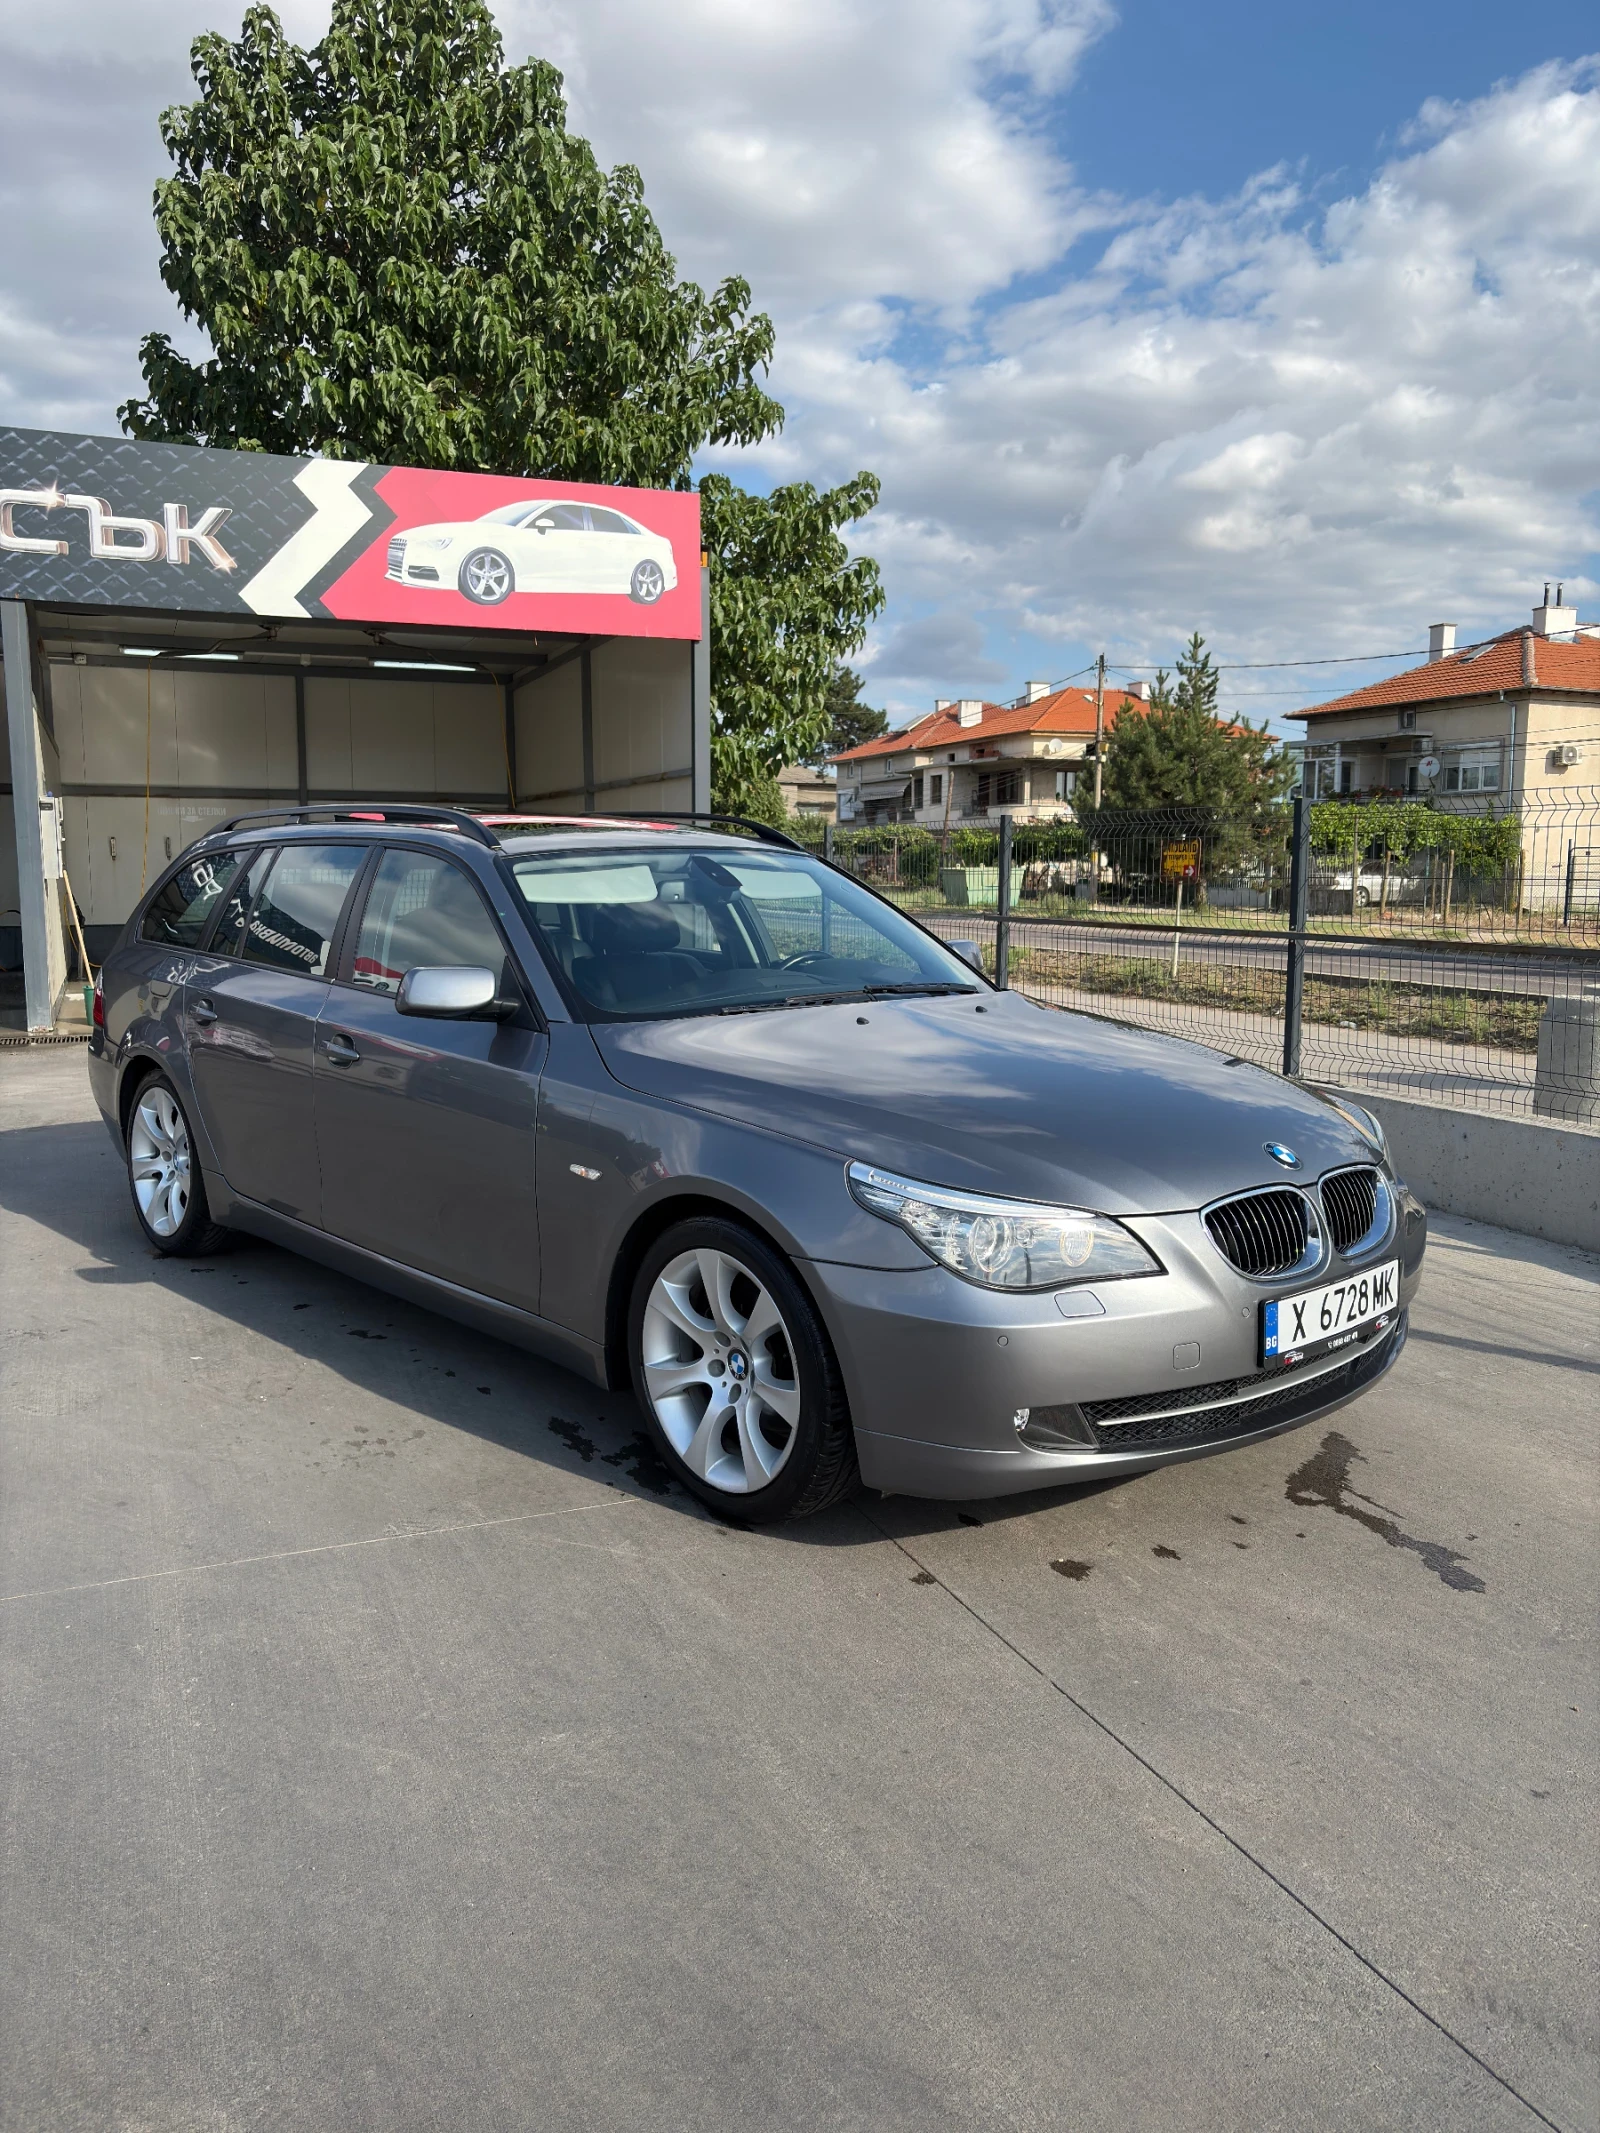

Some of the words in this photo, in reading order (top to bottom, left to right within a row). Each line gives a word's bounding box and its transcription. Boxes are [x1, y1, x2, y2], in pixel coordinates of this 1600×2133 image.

[187, 807, 196, 815] ЗА
[198, 807, 226, 816] СТЕЛКИ
[1292, 1300, 1306, 1342] X
[1320, 1279, 1369, 1331] 6728
[1373, 1267, 1394, 1311] MK
[1266, 1335, 1277, 1350] BG
